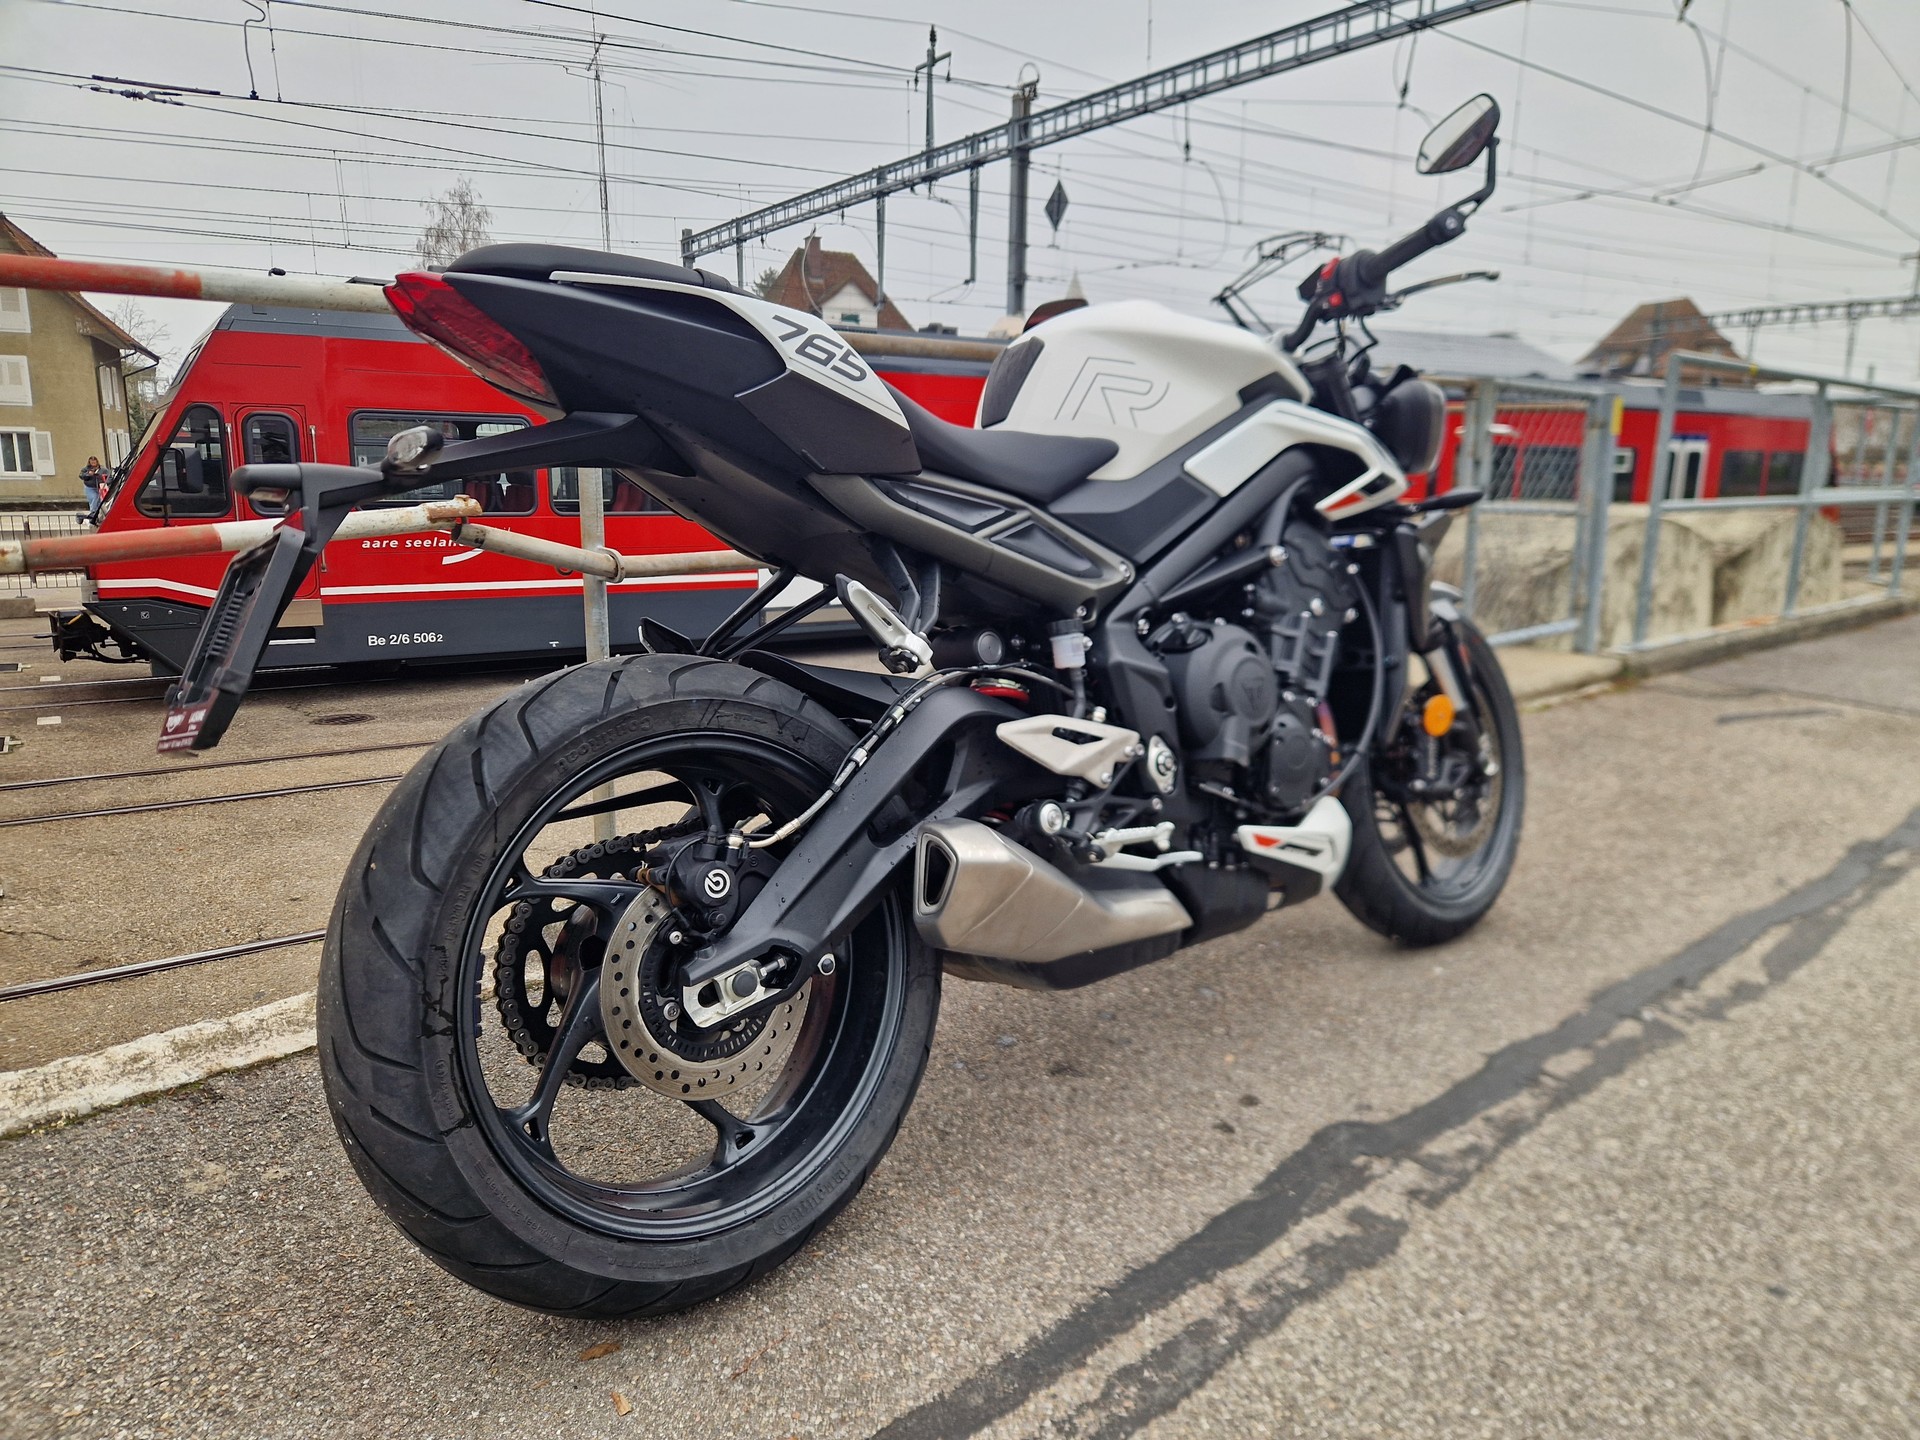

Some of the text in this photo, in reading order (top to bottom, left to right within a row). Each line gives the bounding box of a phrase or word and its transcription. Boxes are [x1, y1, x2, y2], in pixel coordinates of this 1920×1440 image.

[772, 314, 867, 382] 765
[1054, 356, 1171, 428] R
[361, 538, 399, 549] aare
[367, 635, 386, 646] Be
[389, 633, 410, 645] 2/6
